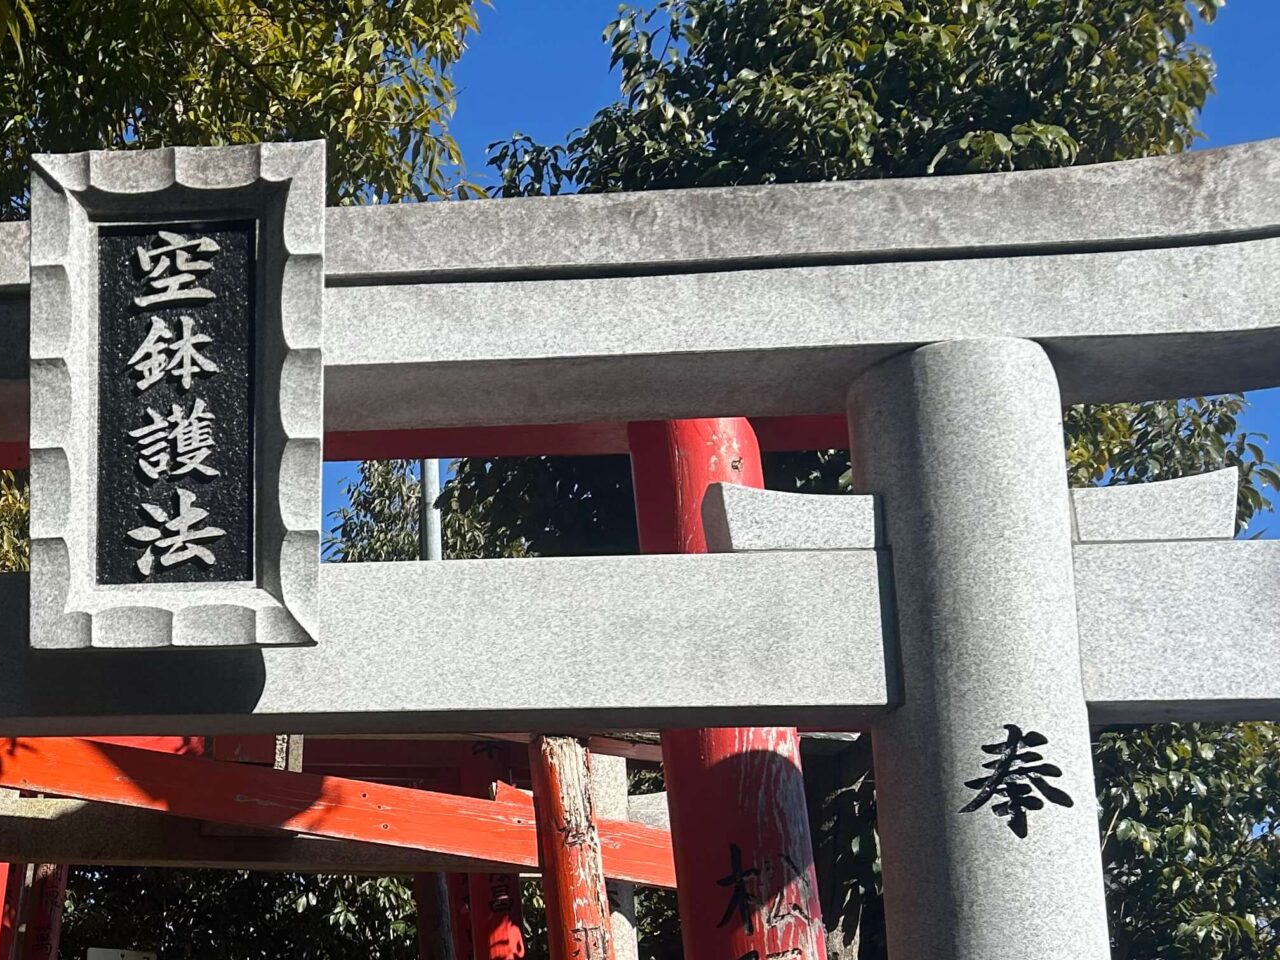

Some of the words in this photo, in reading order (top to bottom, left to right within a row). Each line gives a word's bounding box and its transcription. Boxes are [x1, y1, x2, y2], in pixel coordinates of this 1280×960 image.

[126, 229, 227, 578] 空鉢護法
[959, 724, 1075, 838] 奉
